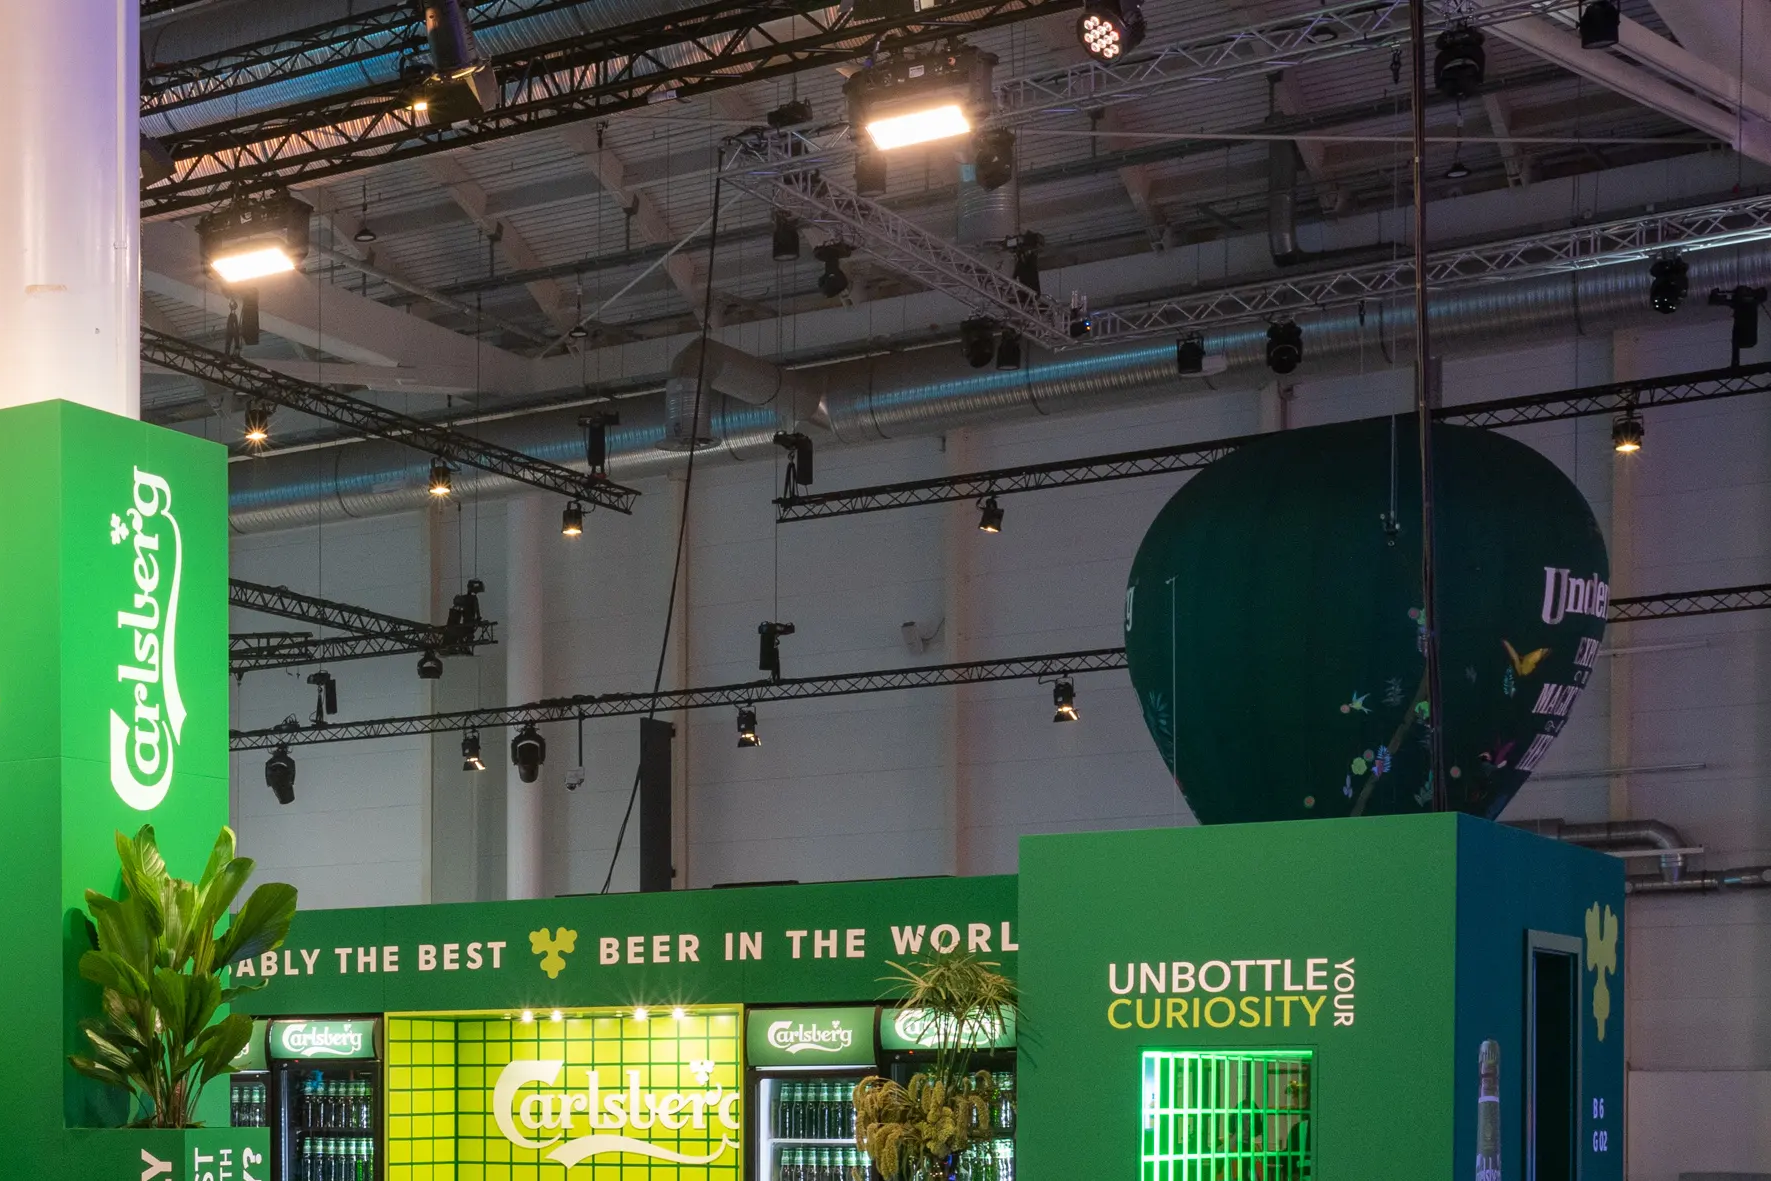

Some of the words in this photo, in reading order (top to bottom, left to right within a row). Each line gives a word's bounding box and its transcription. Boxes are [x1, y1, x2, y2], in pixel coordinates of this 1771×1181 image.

[110, 465, 182, 811] Carlsberg
[229, 947, 321, 979] ABLY
[334, 945, 400, 974] THE
[418, 941, 507, 971] BEST
[599, 933, 700, 965] BEER
[724, 931, 763, 961] IN
[786, 928, 866, 959] THE
[1108, 957, 1328, 995] UNBOTTLE
[1333, 957, 1355, 1027] YOUR
[1107, 995, 1328, 1029] CURIOSITY
[282, 1023, 363, 1056] Carlsberg
[767, 1019, 853, 1054] Carlsberg
